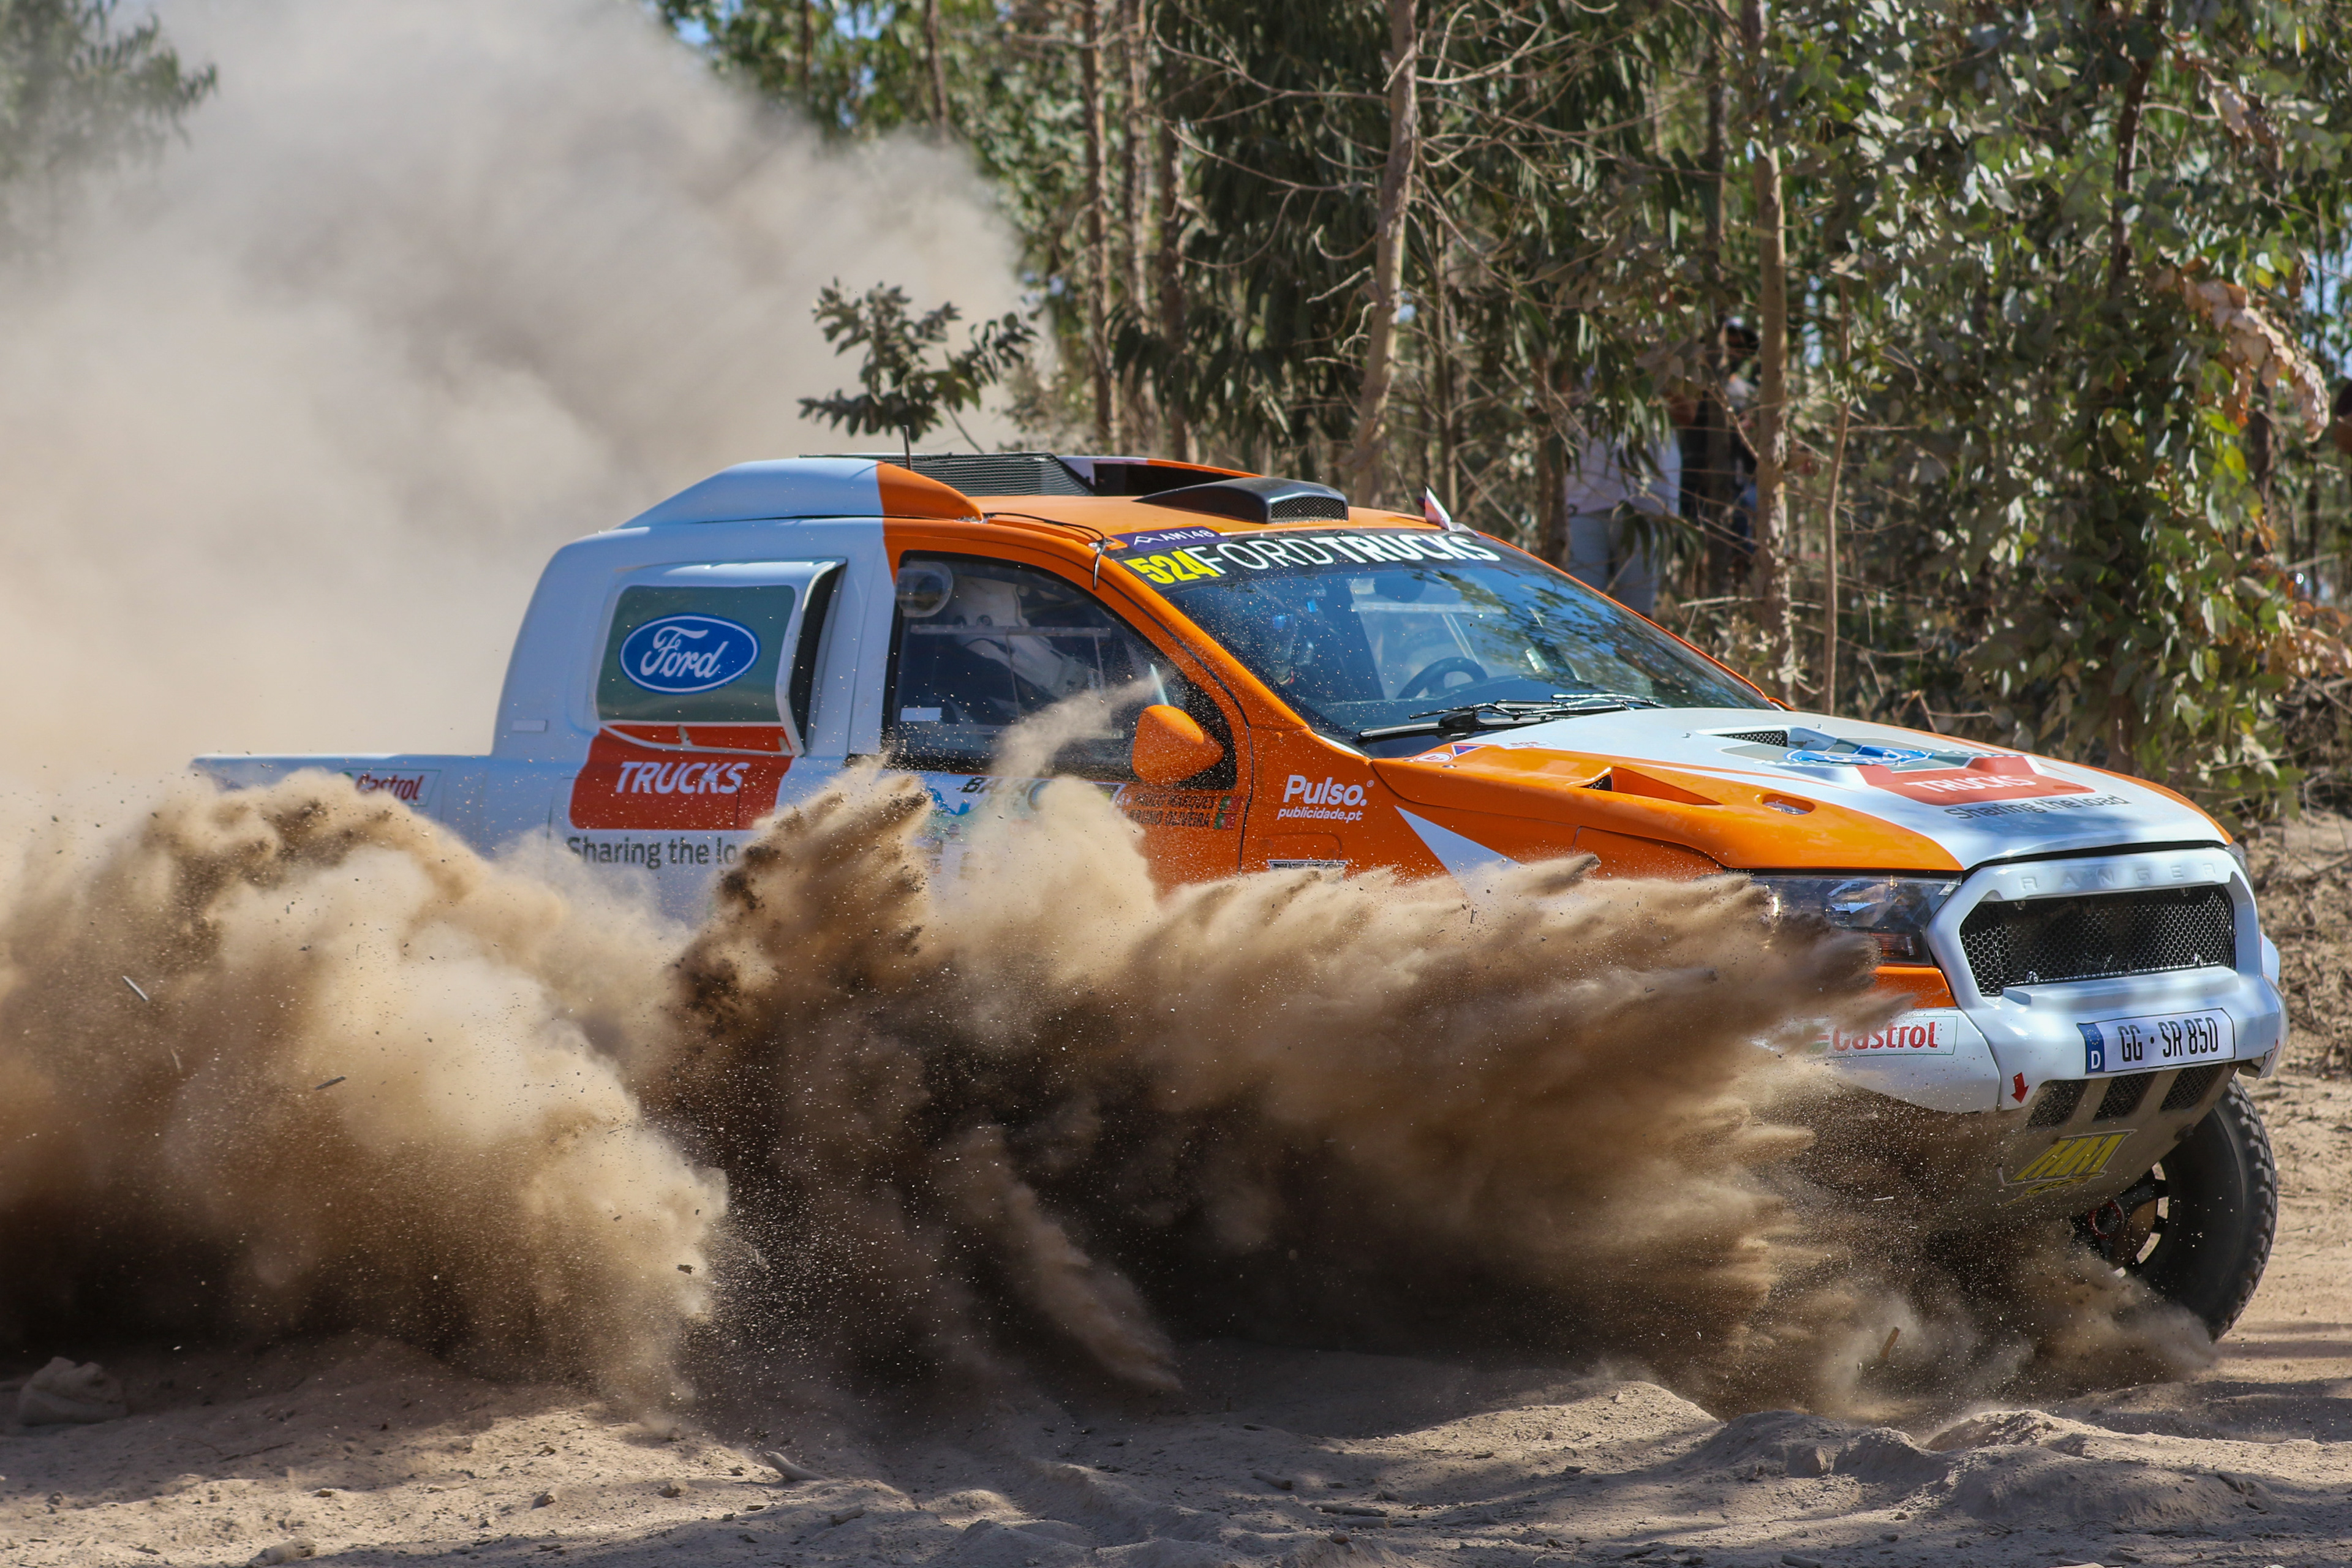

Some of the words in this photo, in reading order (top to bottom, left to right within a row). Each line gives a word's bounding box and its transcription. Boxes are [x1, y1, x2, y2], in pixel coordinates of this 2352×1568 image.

[1123, 550, 1221, 584] 524
[640, 625, 729, 678] Ford
[616, 761, 750, 794] TRUCKS
[1903, 775, 2037, 793] TRUCKS
[1276, 806, 1363, 824] publicidade.pt
[1943, 802, 2048, 820] Sharing
[2037, 797, 2079, 810] the
[2076, 795, 2132, 807] load
[567, 835, 661, 870] Sharing
[668, 837, 709, 865] the
[2021, 864, 2217, 891] RANGER
[1833, 1022, 1938, 1051] Castrol
[2090, 1050, 2101, 1069] D
[2117, 1025, 2143, 1062] GG
[2158, 1021, 2183, 1057] SR
[2184, 1017, 2218, 1054] 850
